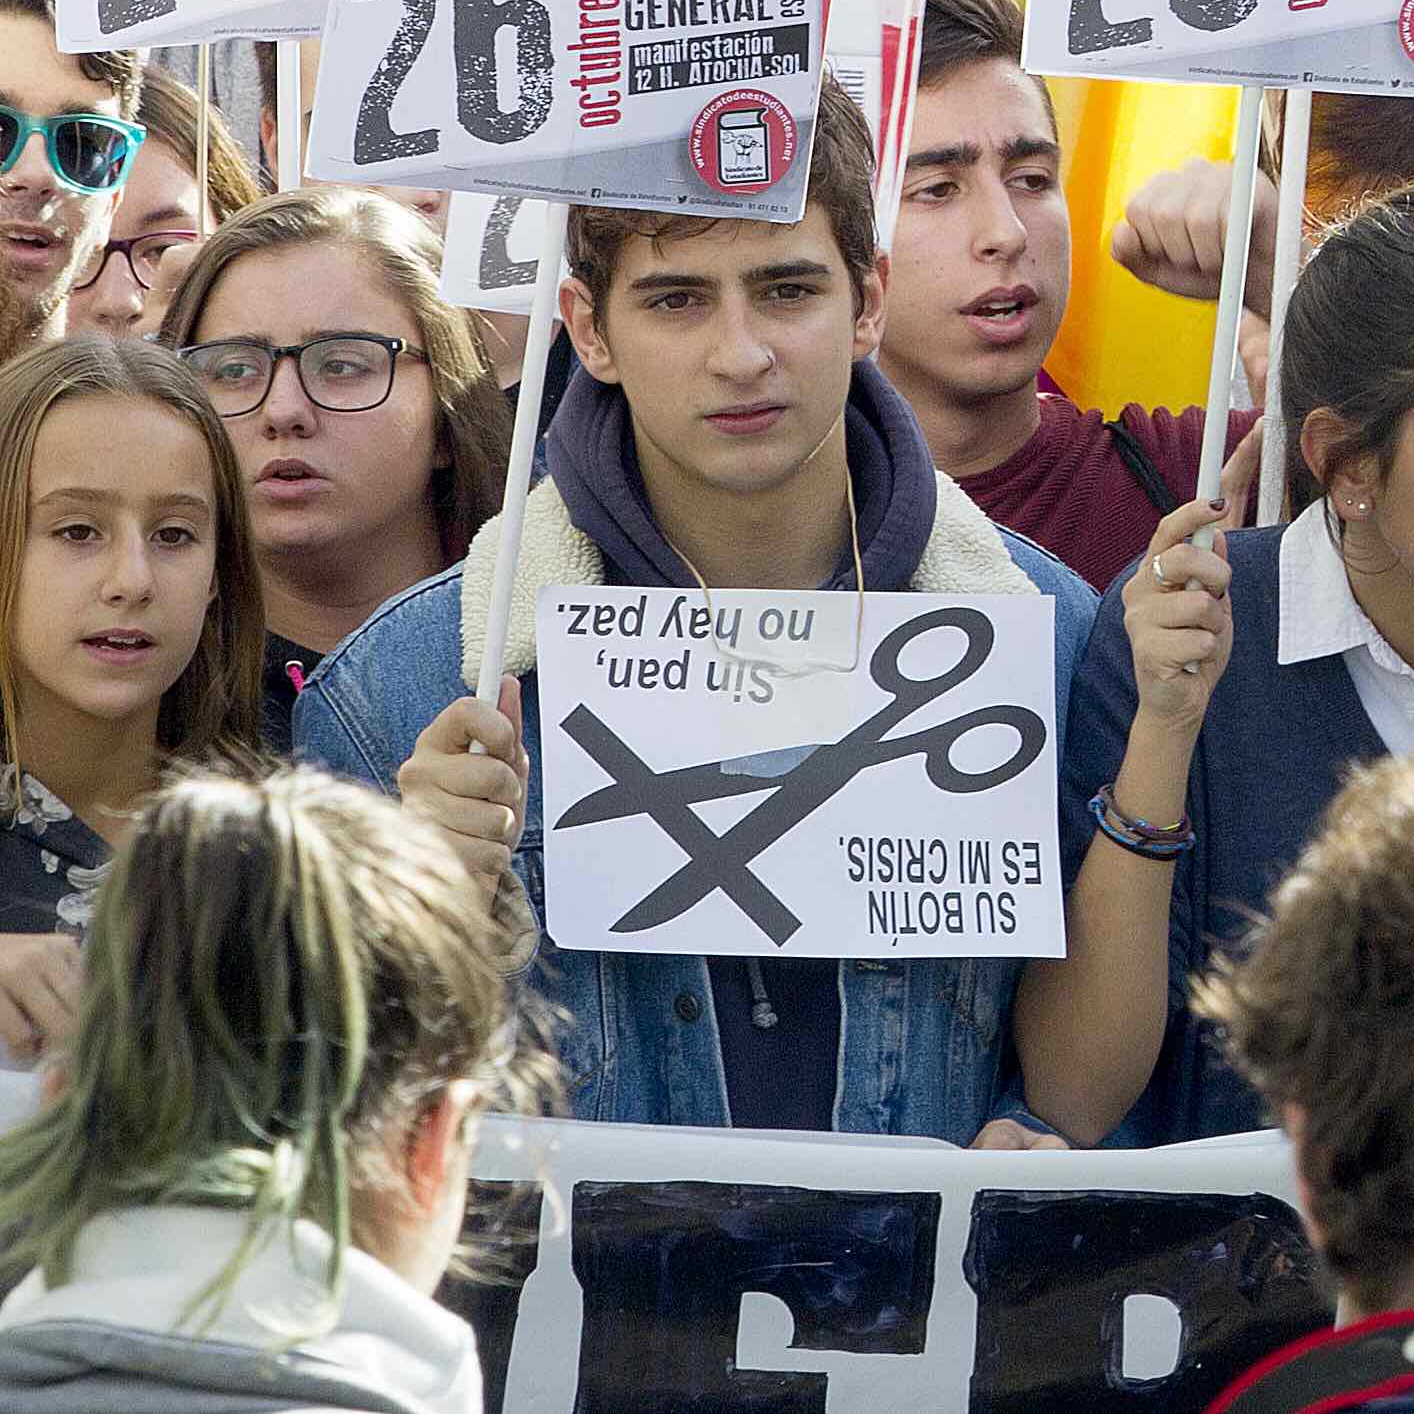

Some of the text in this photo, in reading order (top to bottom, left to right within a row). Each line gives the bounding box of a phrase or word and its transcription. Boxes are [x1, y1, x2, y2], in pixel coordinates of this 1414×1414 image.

[634, 32, 773, 67] manifestación
[635, 68, 651, 91] 12
[691, 92, 792, 169] www.sindicatodeestudiantes.net
[556, 595, 814, 642] no hay paz.
[597, 650, 775, 704] Sin pan,
[839, 838, 1040, 884] ES MI CRISIS.
[868, 890, 1016, 946] SU BOTÍN
